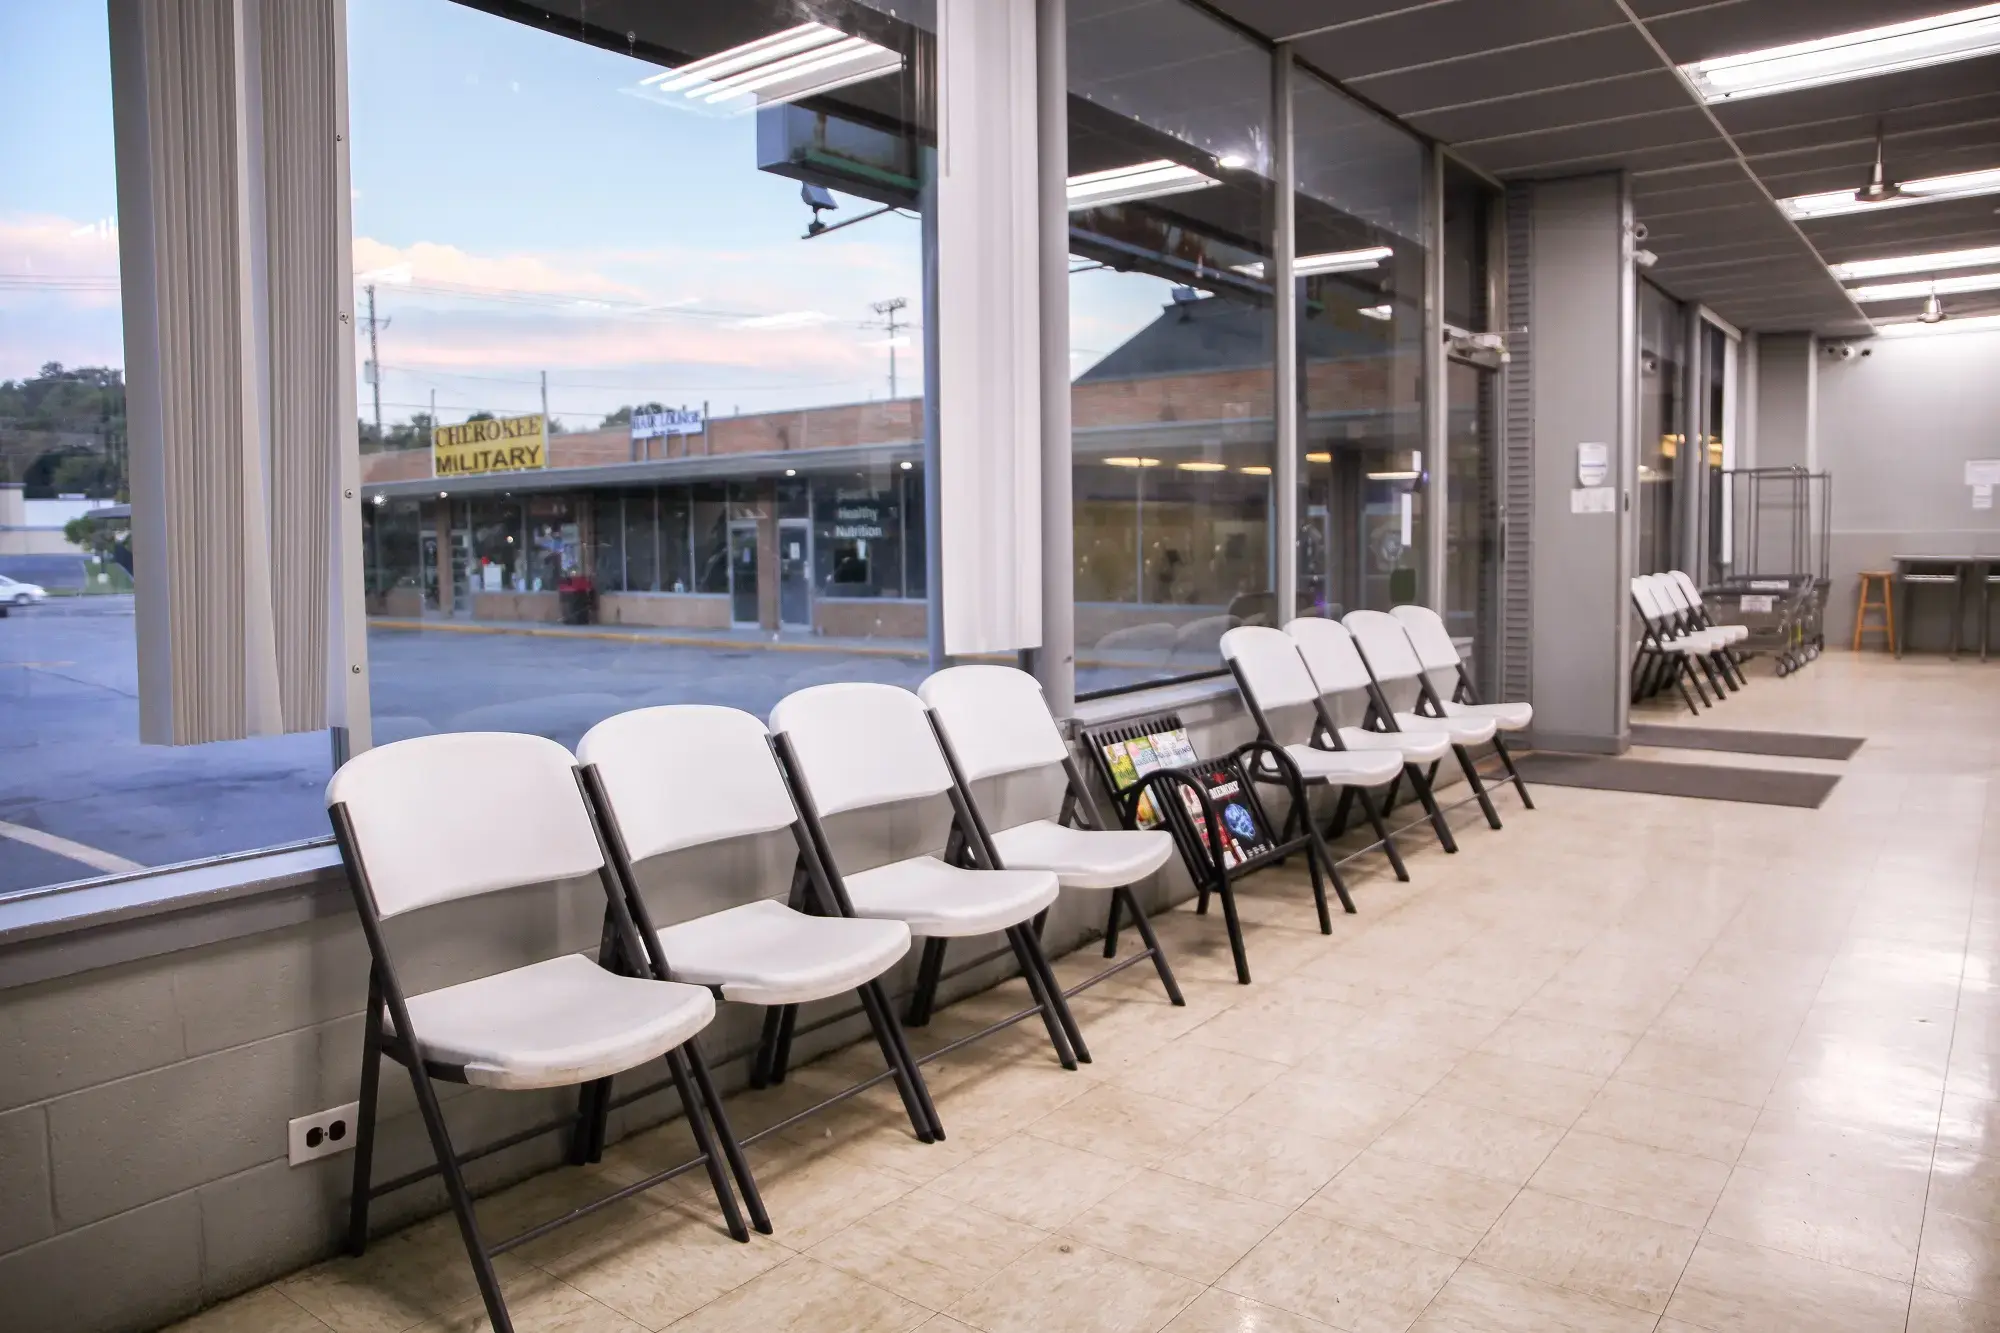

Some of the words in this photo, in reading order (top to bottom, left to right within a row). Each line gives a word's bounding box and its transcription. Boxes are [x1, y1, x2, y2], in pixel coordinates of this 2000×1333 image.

[435, 416, 541, 447] CHEROKEE
[436, 445, 540, 473] MILITARY
[838, 506, 878, 521] Healthy
[836, 524, 883, 537] Nutrition
